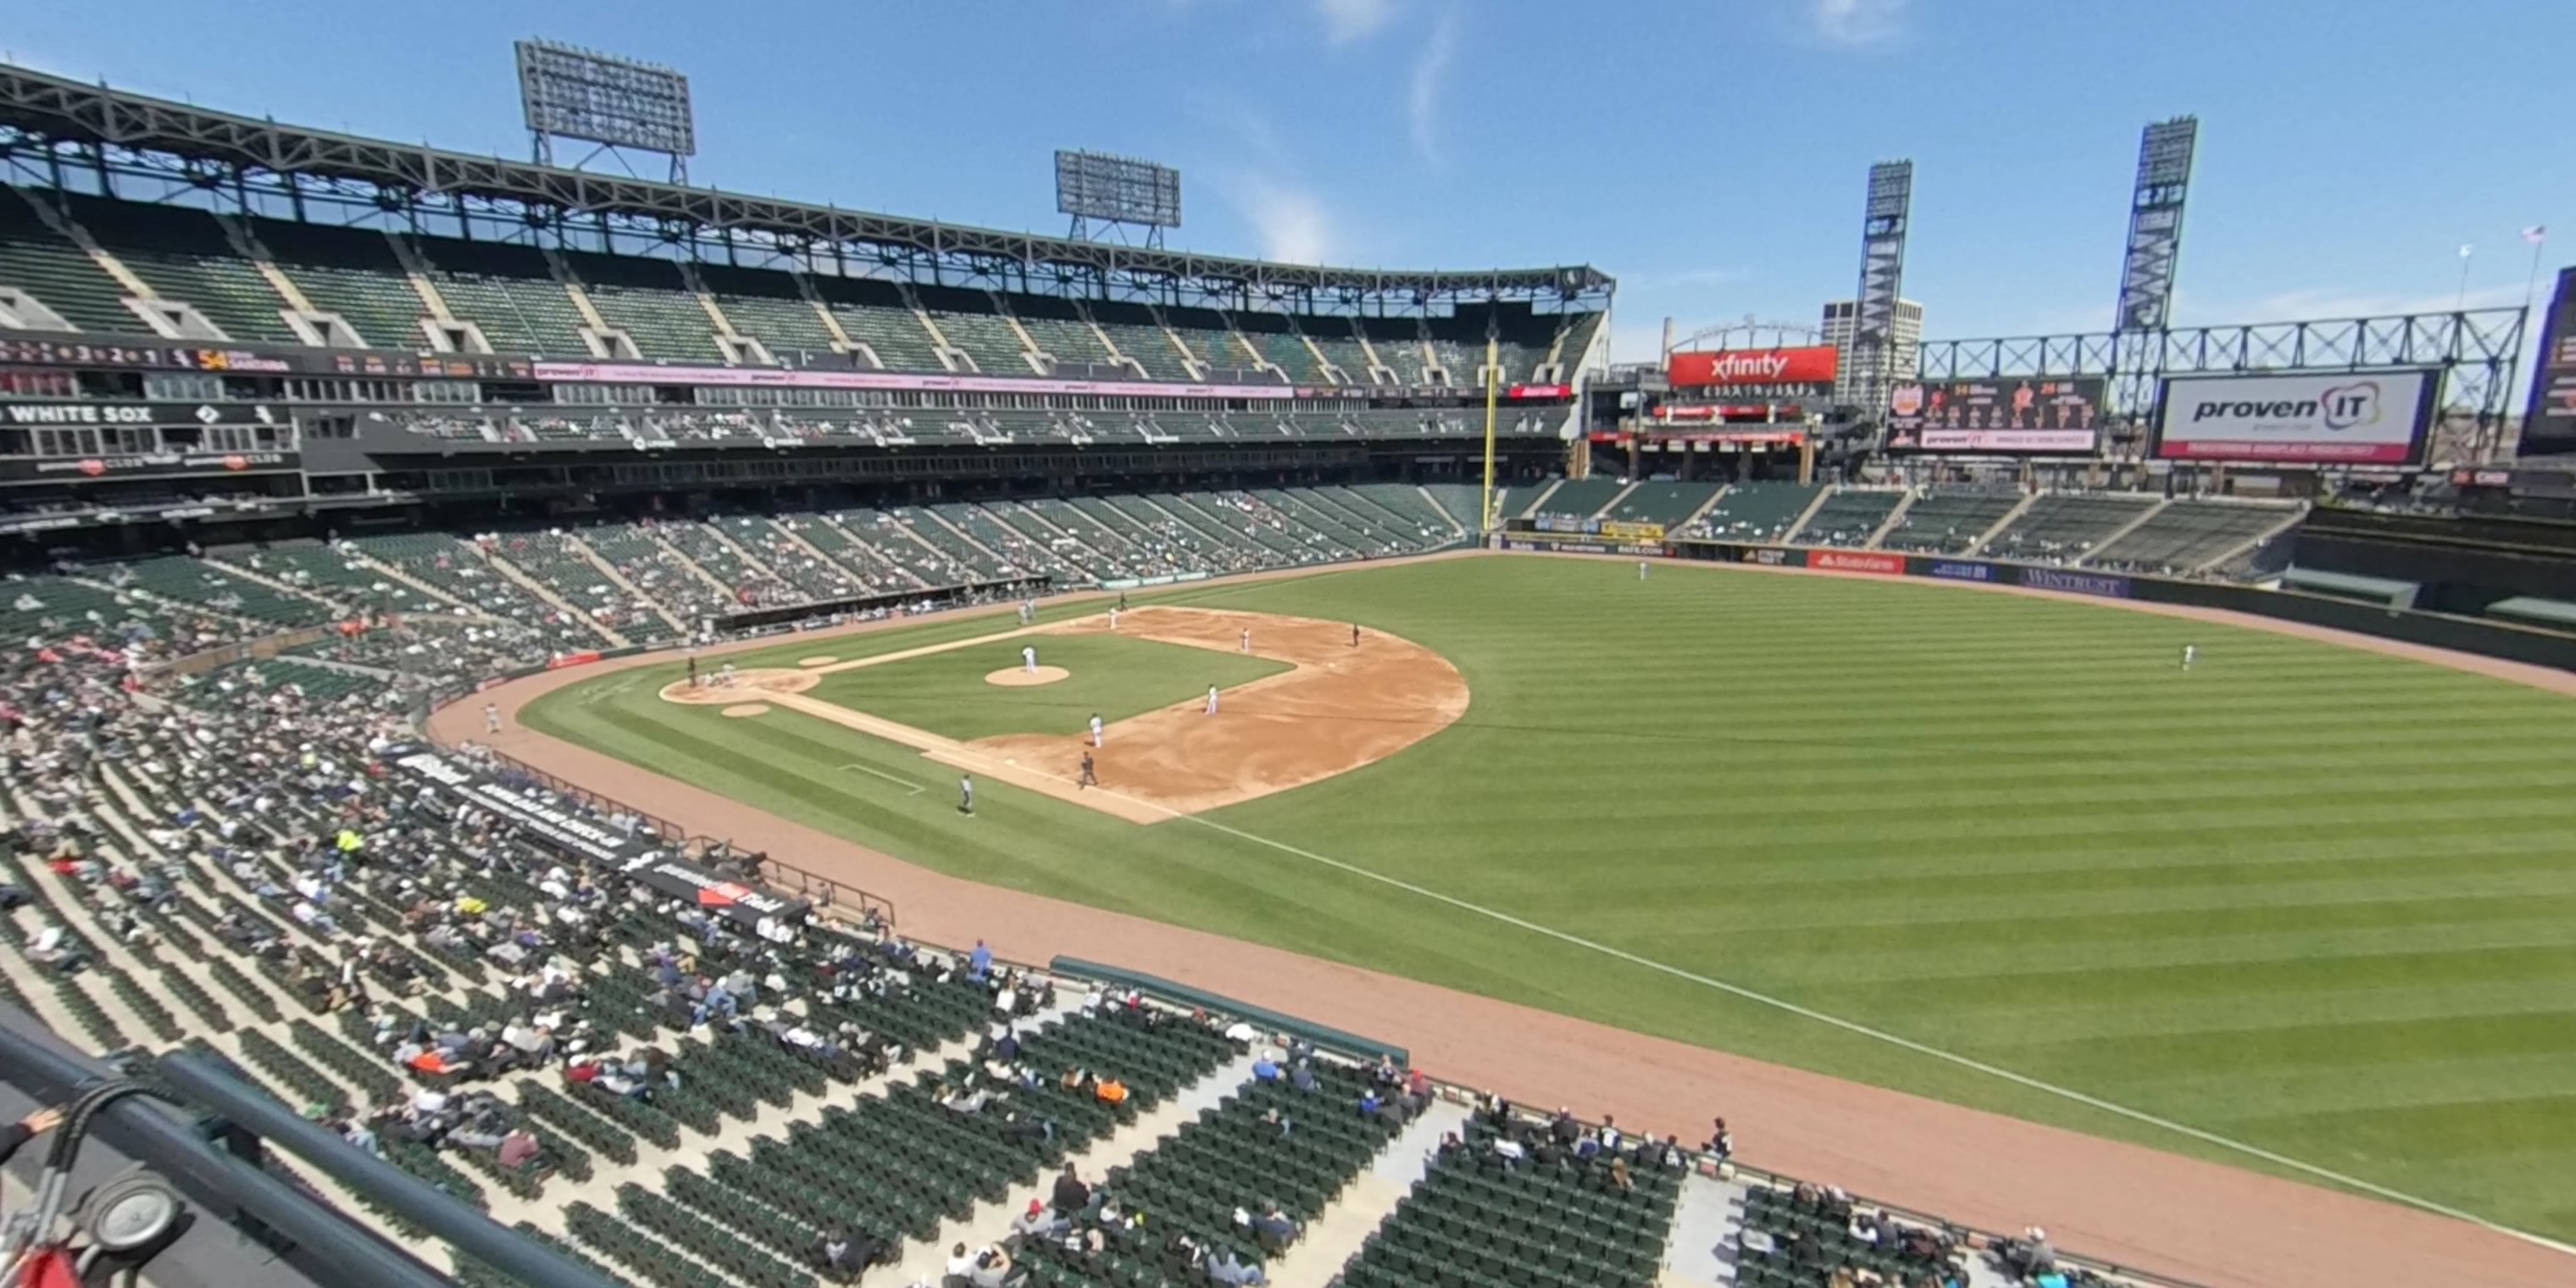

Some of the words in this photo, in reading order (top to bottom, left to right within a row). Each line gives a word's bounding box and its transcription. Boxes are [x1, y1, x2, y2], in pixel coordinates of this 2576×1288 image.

[1710, 353, 1789, 380] xfinity
[8, 405, 99, 423] WHITE
[102, 406, 153, 423] SOX
[2193, 399, 2318, 423] proven
[2334, 396, 2367, 418] IT
[2027, 568, 2120, 595] WINTRUST
